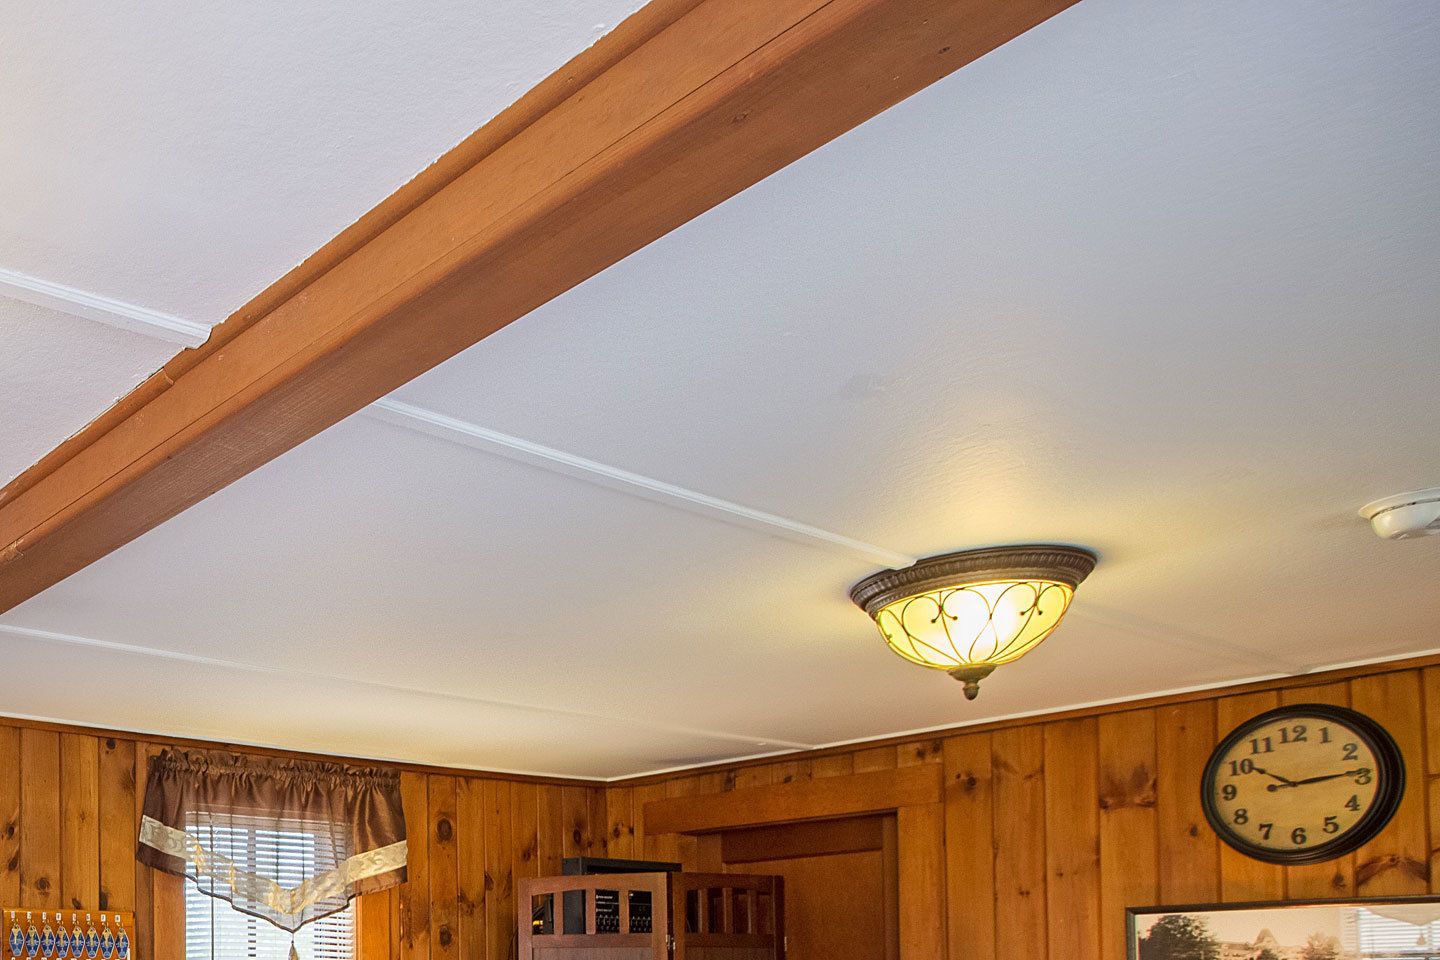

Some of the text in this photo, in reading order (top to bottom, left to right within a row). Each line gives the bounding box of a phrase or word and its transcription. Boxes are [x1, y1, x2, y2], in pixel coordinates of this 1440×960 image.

[1278, 725, 1308, 745] 12
[1318, 727, 1333, 744] 1
[1249, 737, 1275, 755] 11
[1342, 743, 1359, 761] 2
[1228, 758, 1255, 776] 10
[1354, 767, 1372, 785] 3
[1222, 784, 1237, 801] 9
[1344, 794, 1360, 812] 4
[1233, 808, 1249, 825] 8
[1322, 816, 1339, 834] 5
[1258, 823, 1273, 840] 7
[1291, 827, 1307, 845] 6
